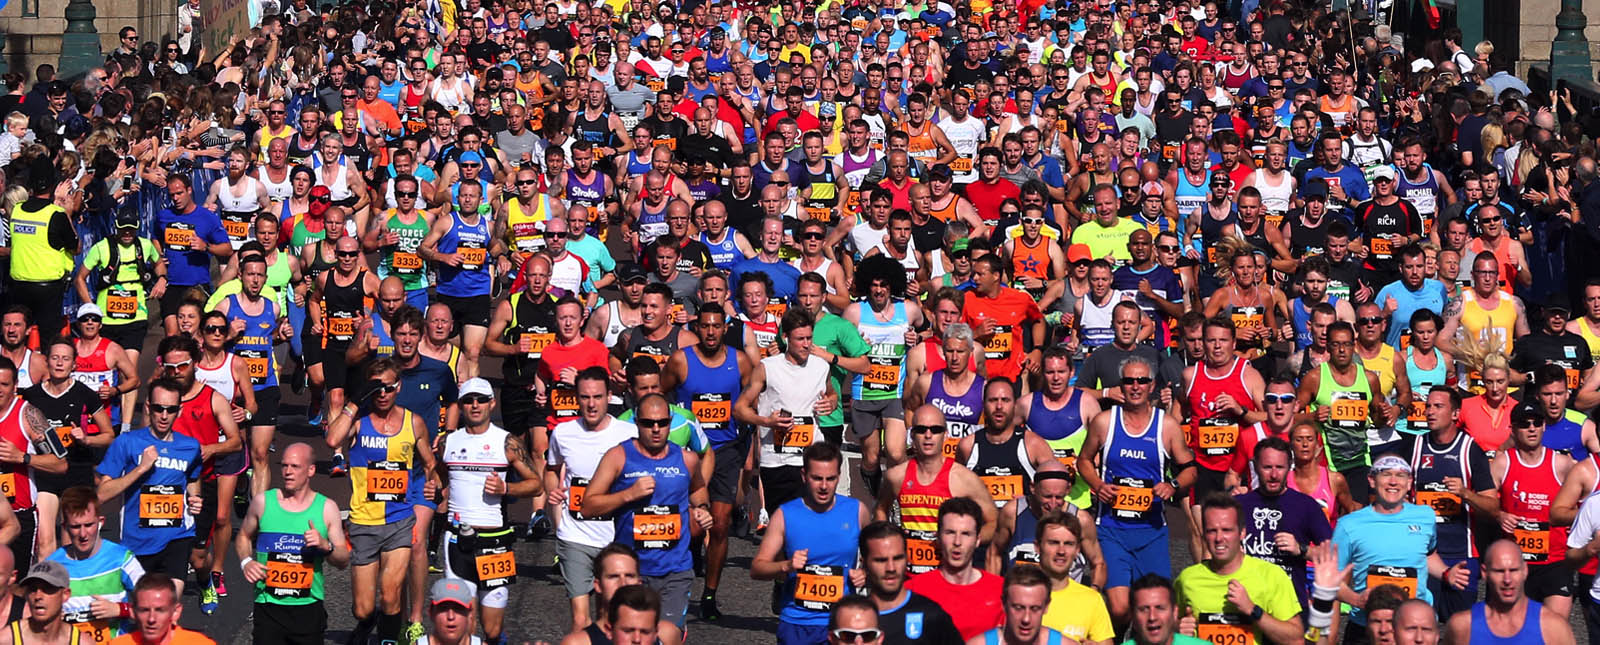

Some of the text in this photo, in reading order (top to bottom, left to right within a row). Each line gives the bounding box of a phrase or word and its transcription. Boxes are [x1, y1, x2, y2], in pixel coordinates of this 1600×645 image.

[572, 186, 600, 199] Stroke
[1406, 188, 1433, 197] MICHAEL
[1377, 217, 1396, 225] RICH
[14, 225, 35, 233] POLICE
[396, 256, 419, 266] 3335
[109, 301, 135, 310] 2938
[871, 344, 897, 356] PAUL
[870, 369, 896, 382] 5453
[697, 408, 727, 419] 4829
[932, 399, 974, 416] Stroke
[1336, 405, 1363, 417] 5115
[361, 437, 388, 449] MARK
[1203, 432, 1235, 444] 3473
[1119, 448, 1148, 460] PAUL
[373, 477, 405, 490] 1206
[984, 484, 1016, 497] 311
[1119, 493, 1150, 507] 2549
[1527, 493, 1549, 501] BOBBY
[1527, 498, 1550, 506] MOORE
[145, 501, 180, 514] 1506
[639, 522, 676, 536] 2298
[1242, 530, 1273, 556] Kids
[1512, 536, 1544, 549] 483
[482, 559, 512, 576] 5133
[271, 570, 308, 585] 2697
[802, 582, 837, 598] 1409
[1206, 633, 1248, 645] 4929
